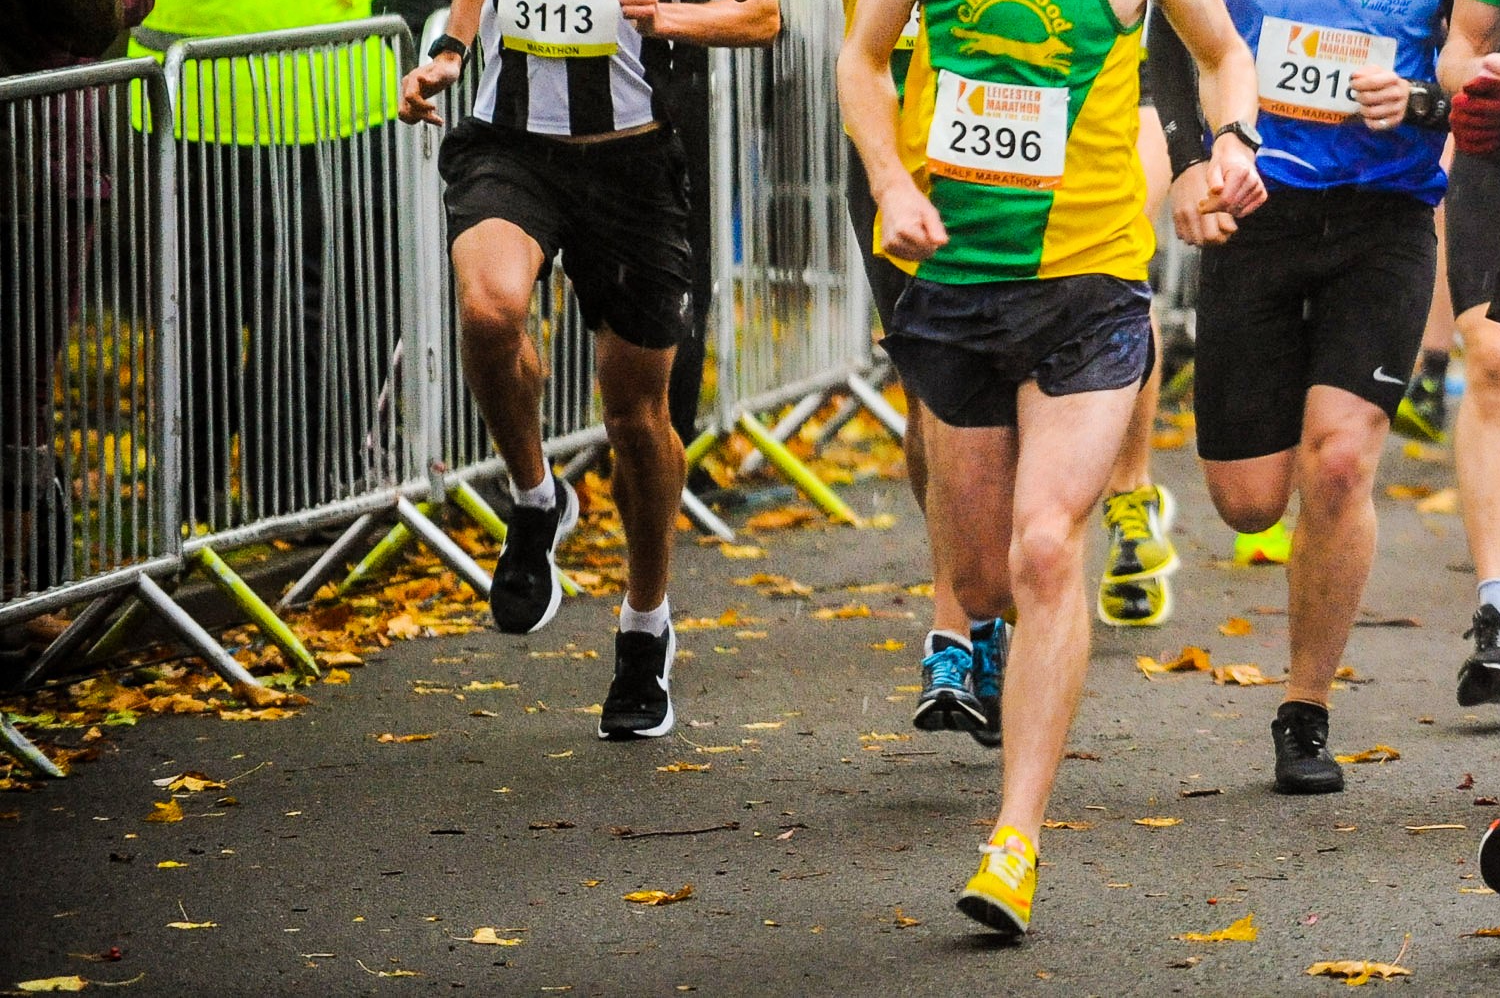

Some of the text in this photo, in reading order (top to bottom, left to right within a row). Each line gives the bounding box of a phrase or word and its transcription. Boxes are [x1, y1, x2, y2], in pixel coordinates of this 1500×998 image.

[514, 1, 593, 34] 3113
[1321, 30, 1371, 48] LEICESTER
[527, 43, 580, 55] MARATHON
[986, 85, 1041, 102] LEICESTER
[986, 99, 1041, 114] MARATHON
[949, 120, 1042, 163] 2396
[943, 166, 1042, 187] HALF MARATHON
